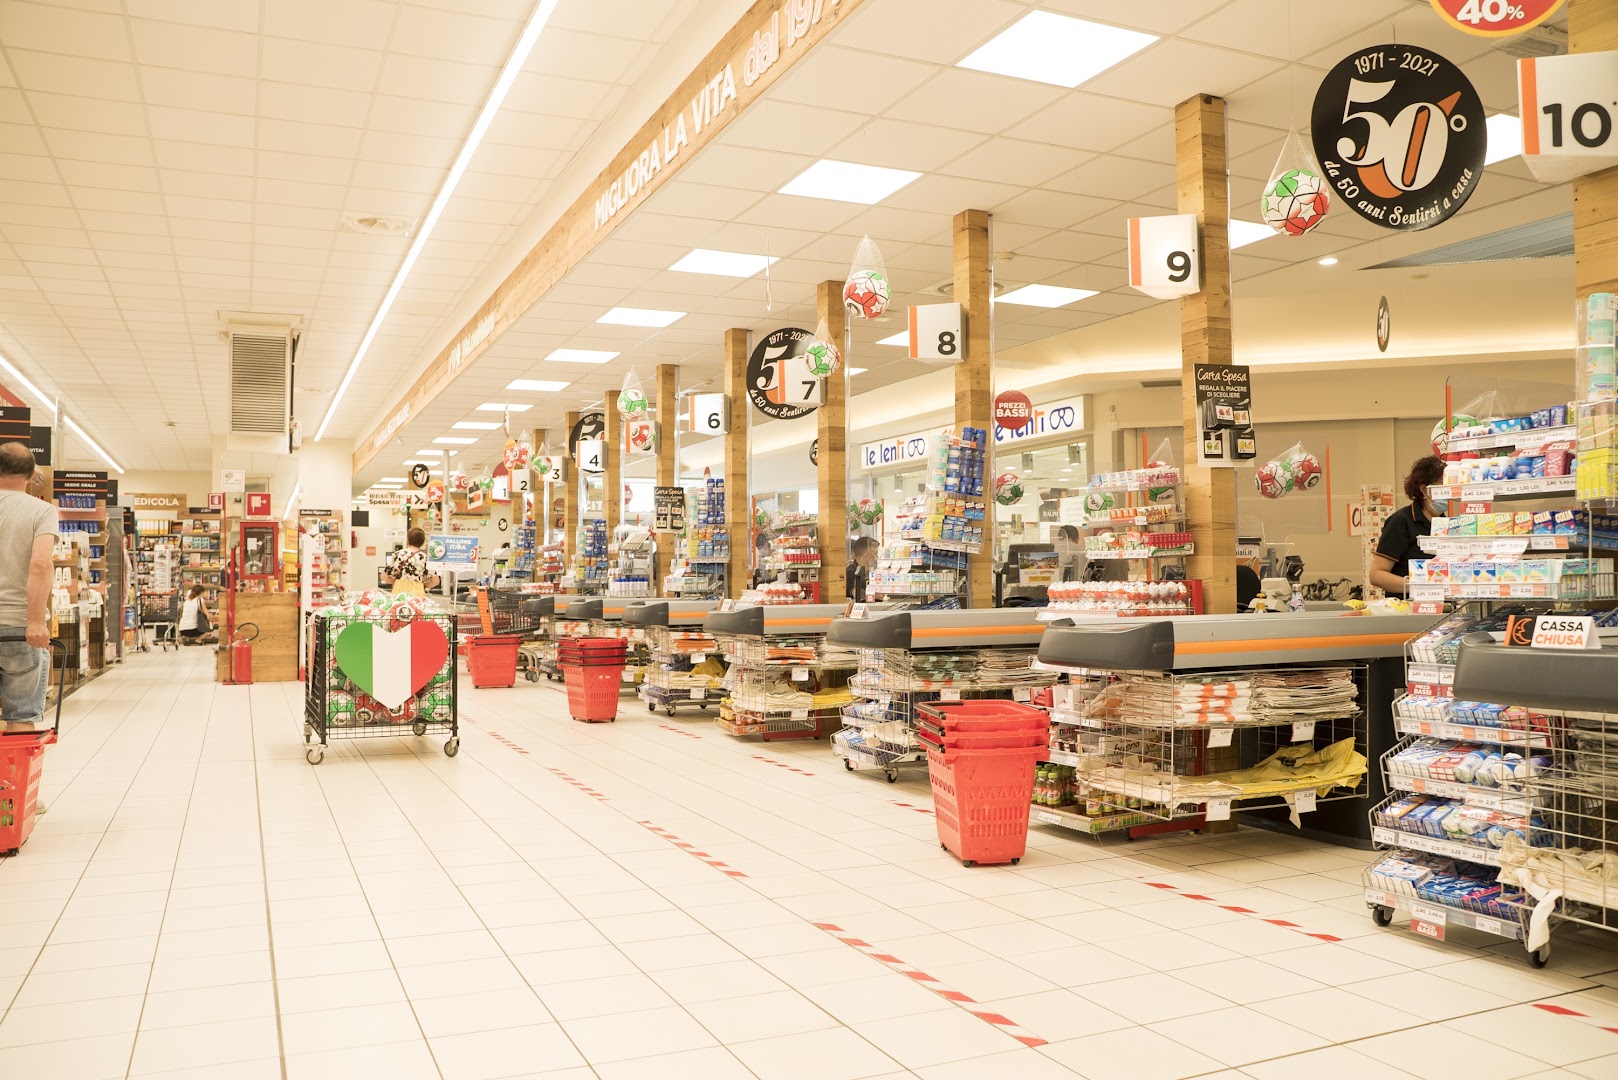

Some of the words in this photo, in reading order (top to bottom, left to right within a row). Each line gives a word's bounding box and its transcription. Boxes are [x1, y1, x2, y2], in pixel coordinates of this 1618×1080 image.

[1456, 0, 1525, 24] 40%
[1354, 52, 1384, 75] 1971
[1400, 52, 1440, 77] 2021
[594, 139, 662, 232] MIGLIORA
[664, 112, 688, 164] LA
[691, 63, 738, 135] VITA
[744, 10, 780, 87] dal
[1542, 102, 1612, 148] 10
[1324, 160, 1340, 178] da
[1337, 177, 1360, 198] 50
[1357, 201, 1387, 220] anni
[1388, 200, 1441, 226] Sentirsi
[1443, 196, 1452, 210] a
[1451, 168, 1473, 200] casa
[1166, 250, 1192, 282] 9
[768, 332, 784, 346] 1971
[937, 331, 956, 356] 8
[1197, 368, 1221, 381] Carta
[1222, 369, 1247, 386] Spesa
[802, 380, 816, 400] 7
[750, 389, 758, 398] da
[754, 396, 766, 408] 50
[764, 406, 780, 416] anni
[707, 412, 721, 430] 6
[996, 408, 1029, 418] BASSI
[590, 454, 600, 467] 4
[866, 446, 876, 466] le
[880, 440, 904, 463] lenti
[552, 468, 560, 480] 3
[502, 488, 507, 498] 1
[520, 480, 528, 491] 2
[134, 497, 179, 506] EDICOLA
[1540, 621, 1584, 632] CASSA
[1535, 634, 1584, 646] CHIUSA
[1416, 926, 1438, 937] BASSI
[1418, 922, 1436, 930] PREZZI
